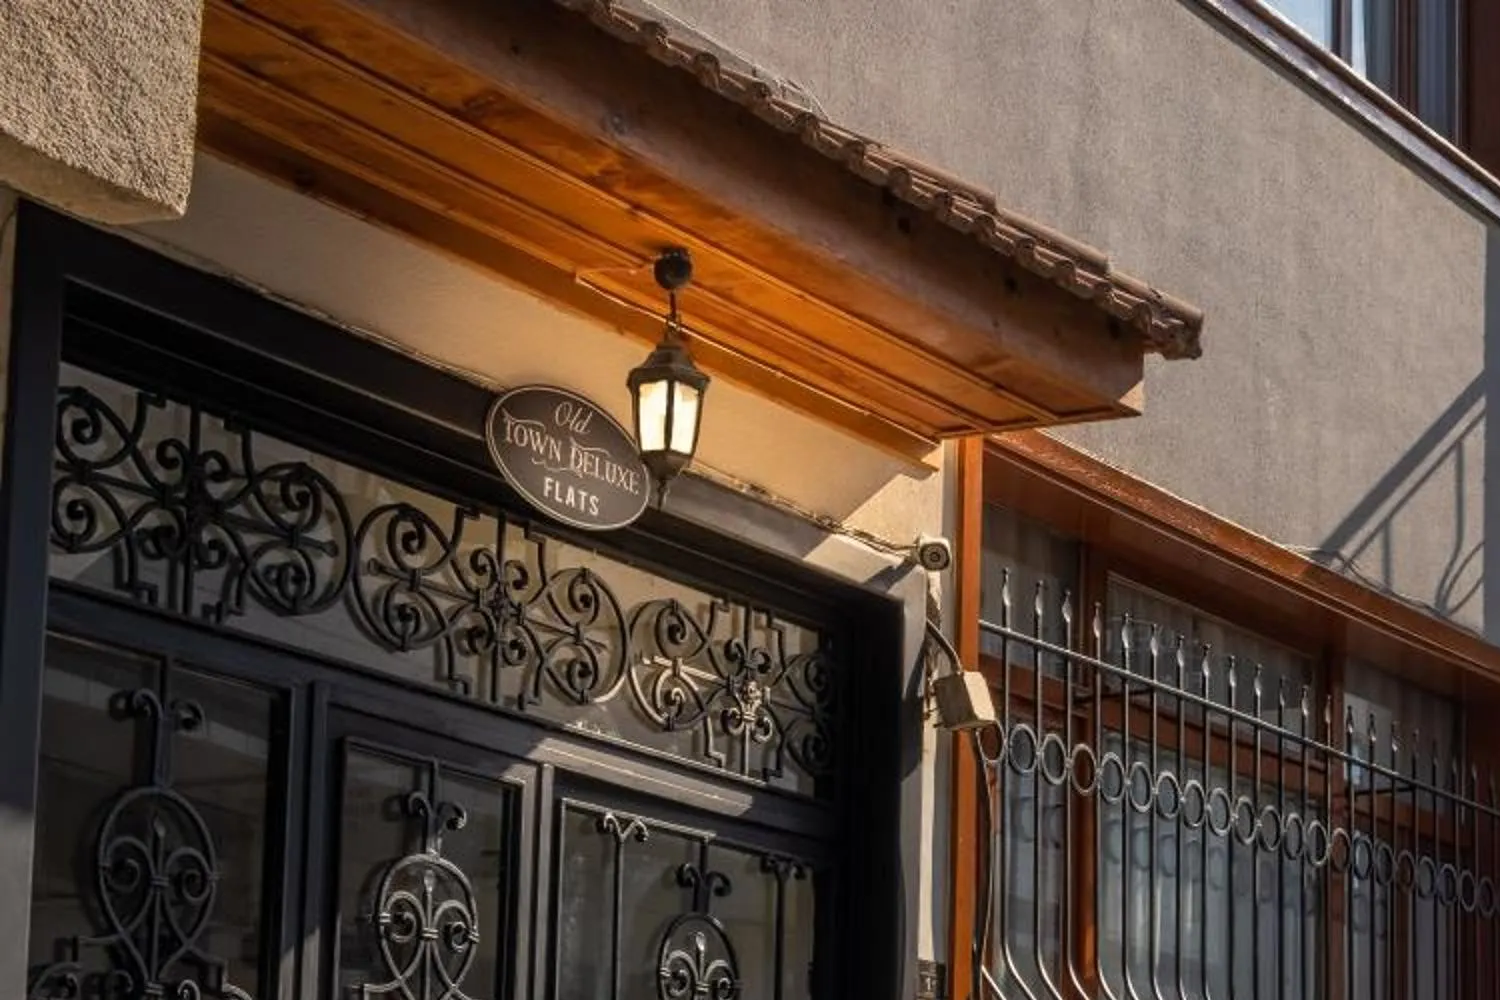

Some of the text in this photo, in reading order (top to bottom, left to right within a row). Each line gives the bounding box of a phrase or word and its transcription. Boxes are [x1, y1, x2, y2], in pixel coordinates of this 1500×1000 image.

[554, 401, 595, 434] Old
[503, 409, 640, 495] TOWN DELUXE
[543, 477, 600, 517] FLATS
